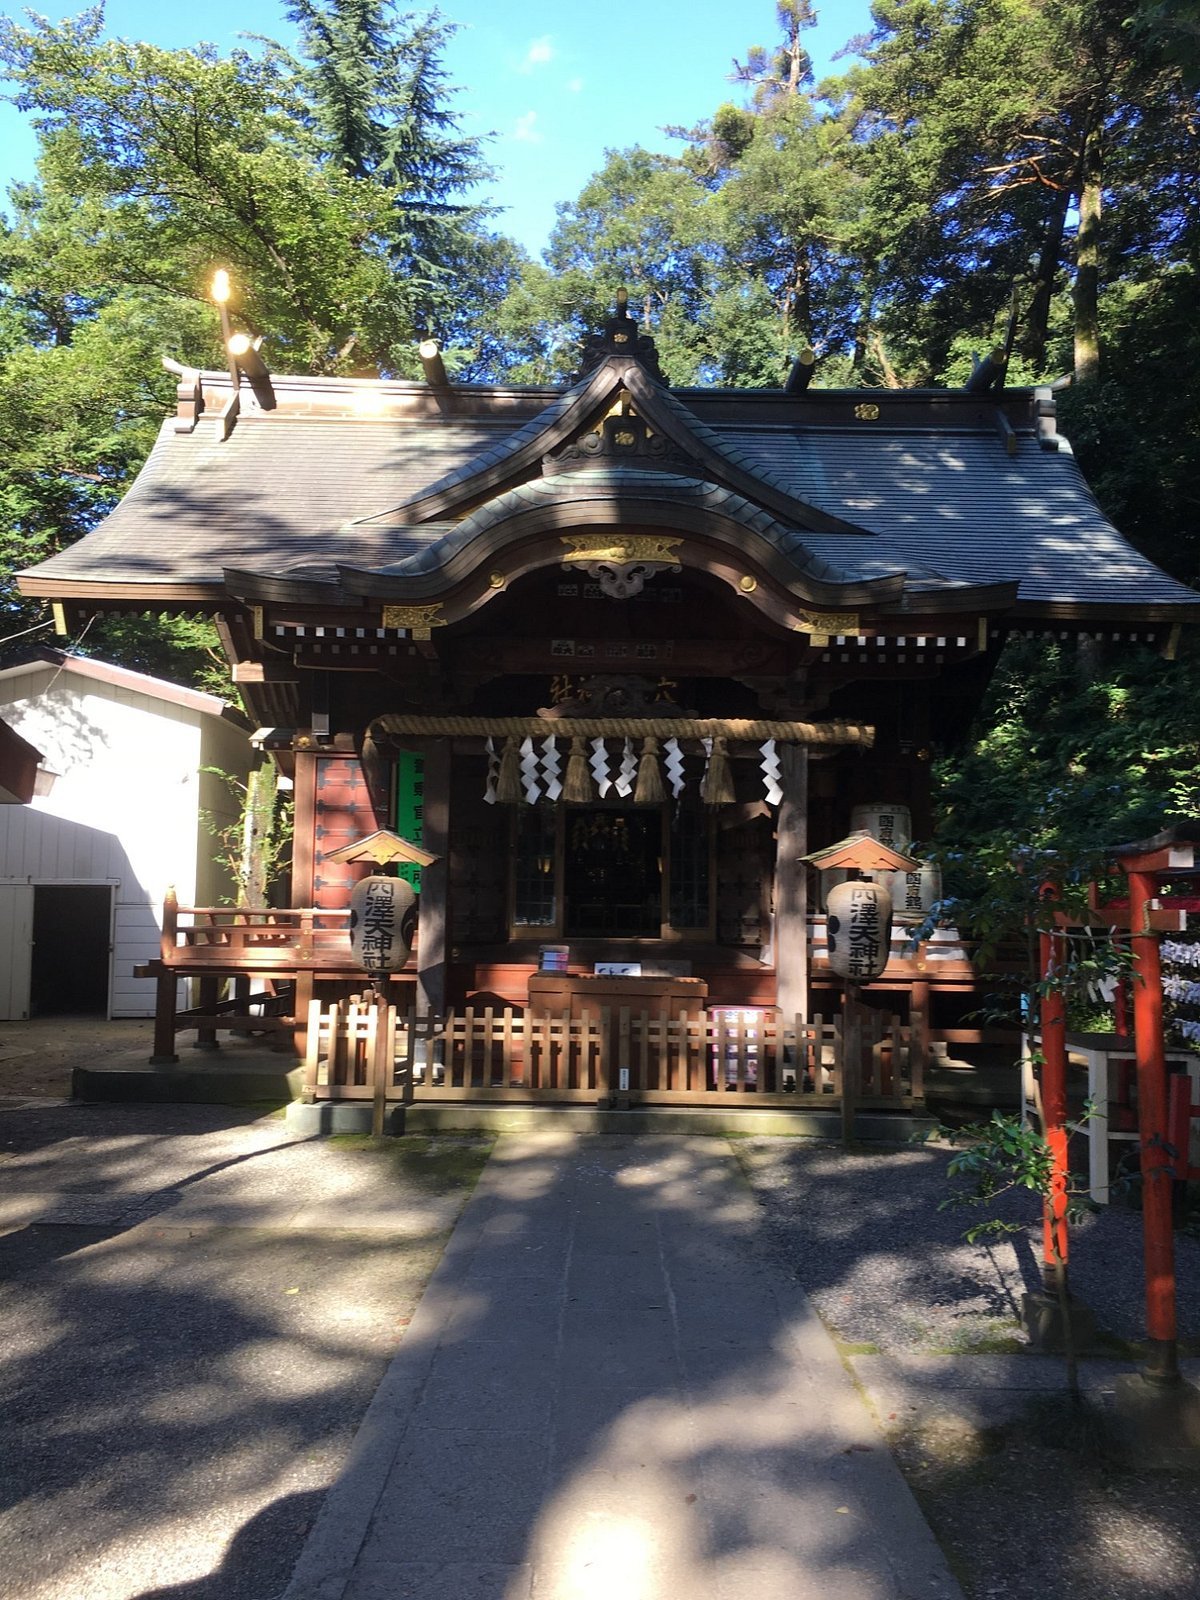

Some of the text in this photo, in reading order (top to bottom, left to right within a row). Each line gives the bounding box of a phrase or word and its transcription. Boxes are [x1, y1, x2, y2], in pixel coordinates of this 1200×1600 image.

[362, 880, 395, 970] 穴澤天神社
[848, 888, 881, 977] 穴澤天神社
